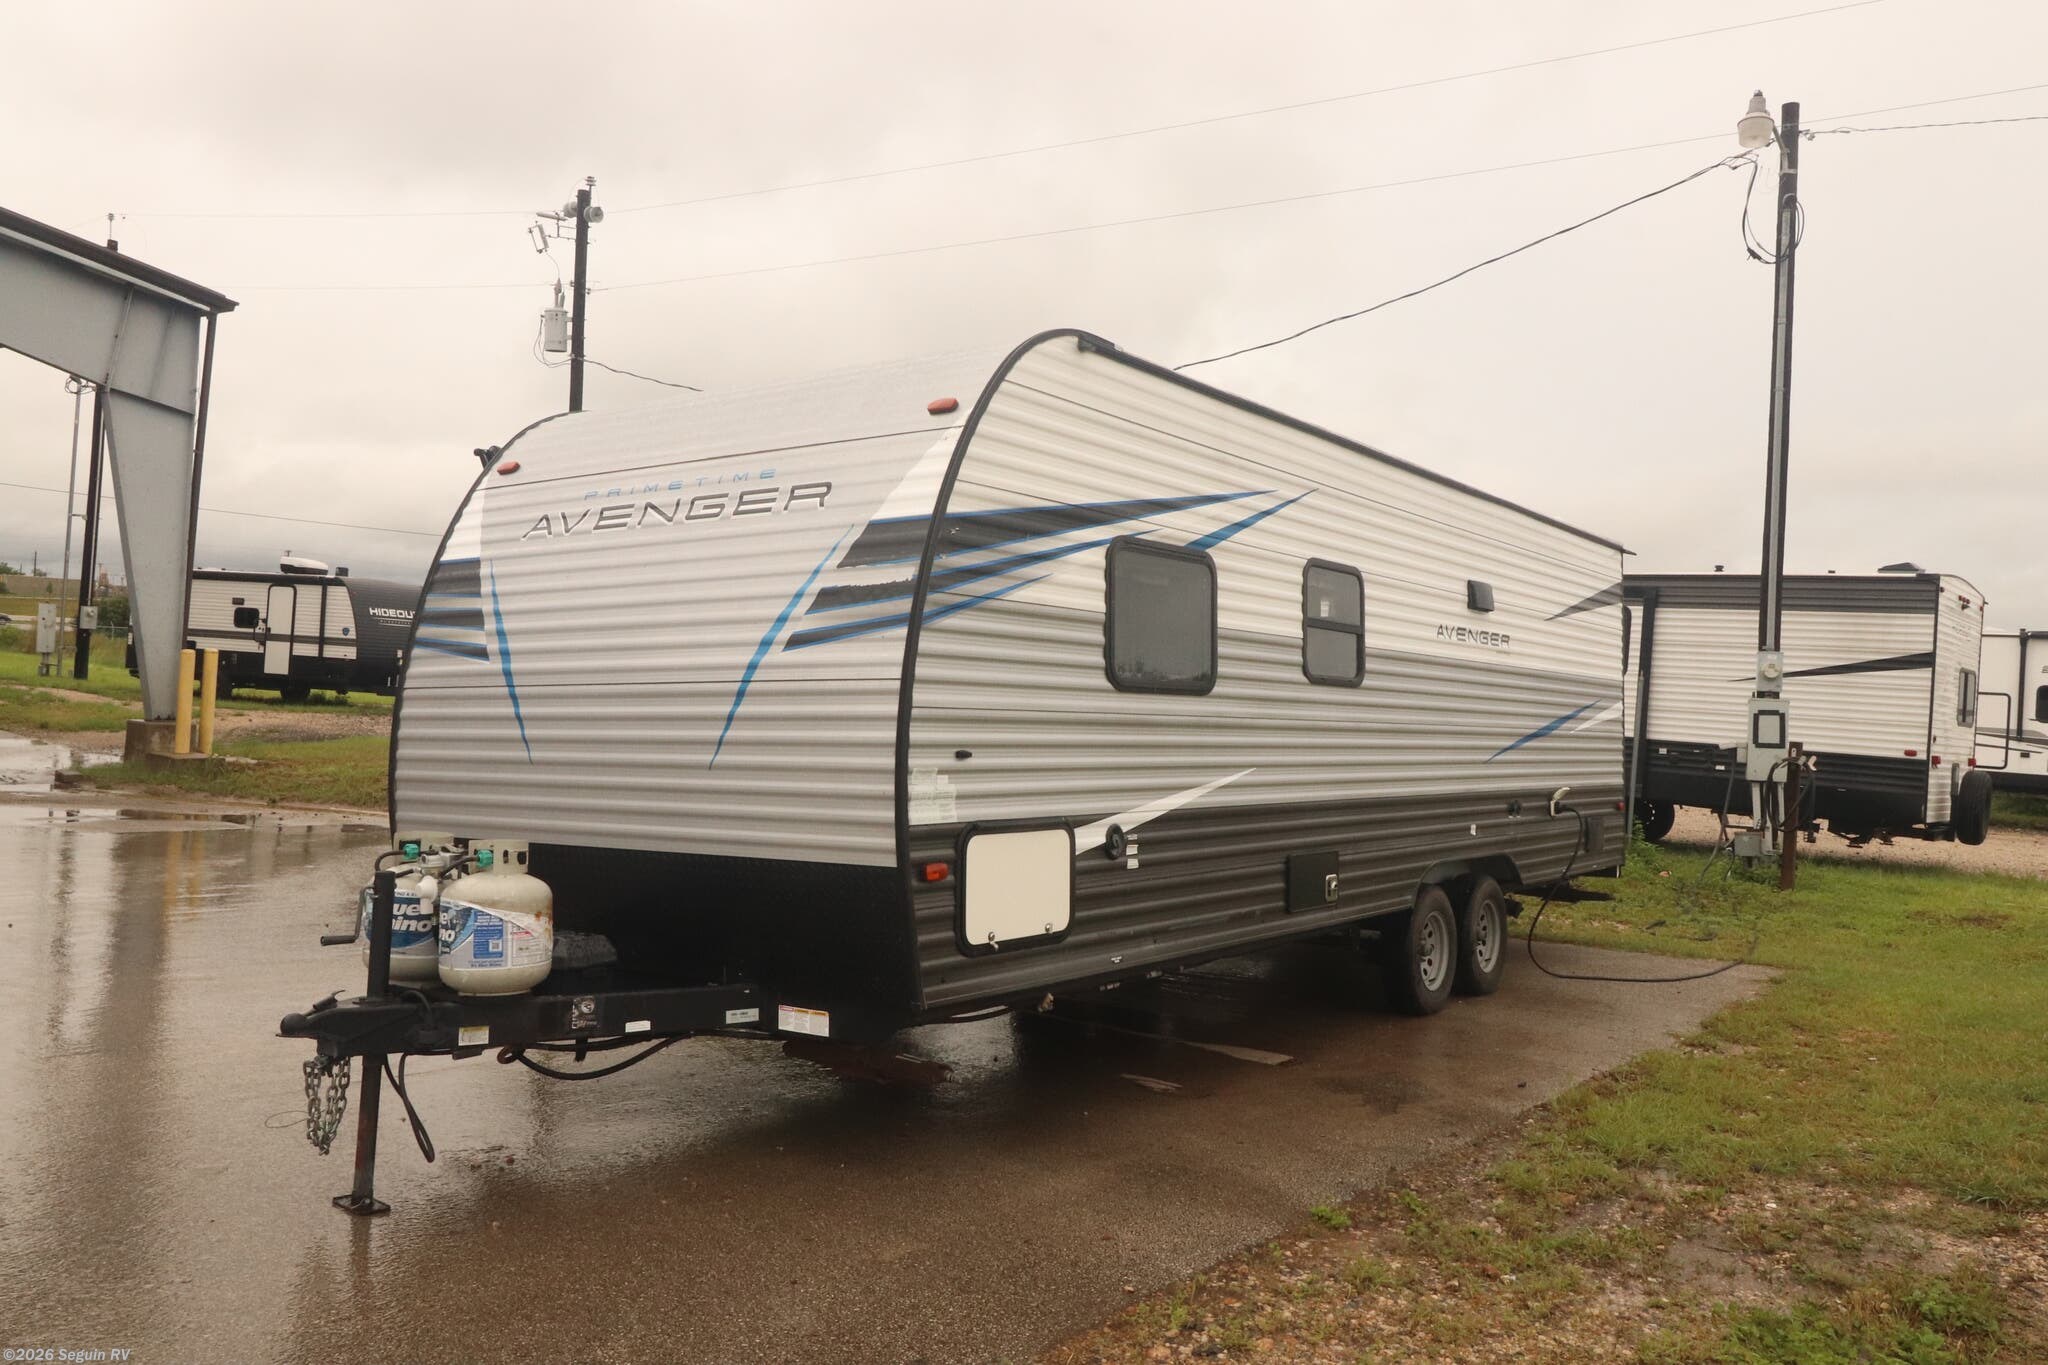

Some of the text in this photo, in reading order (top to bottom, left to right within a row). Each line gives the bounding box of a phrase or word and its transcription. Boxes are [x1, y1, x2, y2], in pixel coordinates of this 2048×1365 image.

[583, 468, 777, 501] PRIMETIME
[520, 480, 833, 542] AVENGER
[1436, 624, 1511, 649] AVENGER
